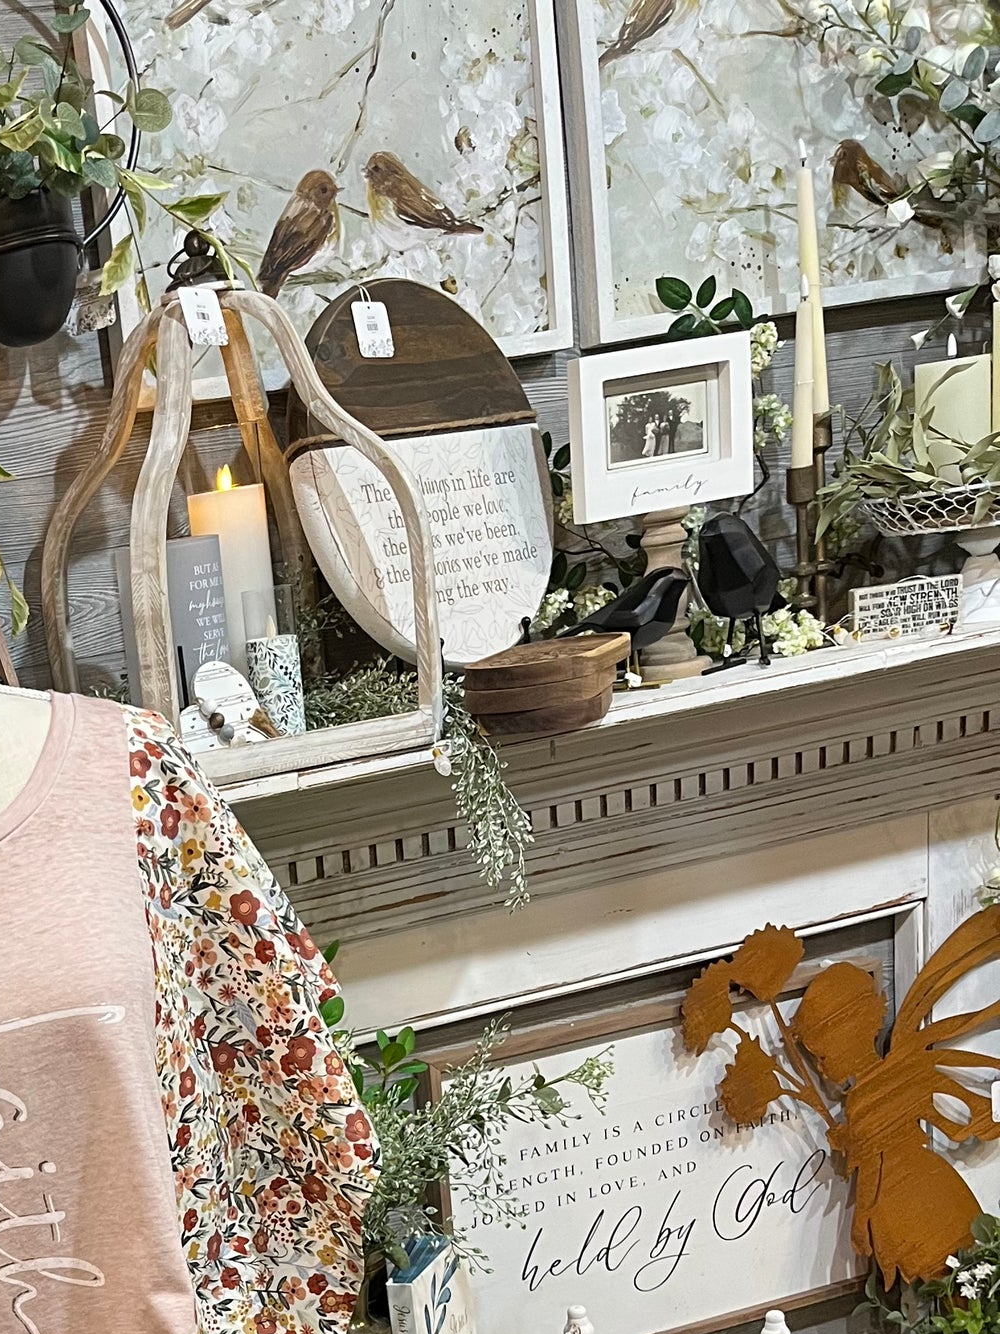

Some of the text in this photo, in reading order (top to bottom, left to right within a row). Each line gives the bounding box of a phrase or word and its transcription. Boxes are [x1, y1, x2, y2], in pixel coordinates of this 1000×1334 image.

[361, 470, 516, 504] The hings in life are
[631, 473, 708, 507] family
[388, 510, 406, 529] th
[426, 502, 460, 526] eople
[463, 502, 483, 517] we
[383, 538, 408, 557] the
[445, 527, 482, 548] we've
[194, 563, 211, 575] BUT
[386, 564, 411, 585] the
[462, 549, 498, 571] we've
[503, 541, 538, 564] made
[189, 579, 208, 591] FOR
[457, 579, 479, 599] the
[482, 576, 514, 594] way.
[896, 584, 917, 595] TRUST
[918, 583, 925, 591] IN
[940, 578, 959, 588] LORD
[196, 616, 211, 627] WE
[904, 604, 921, 615] HIGH
[923, 601, 934, 611] ON
[519, 1132, 592, 1161] FAMILY
[603, 1125, 621, 1141] IS
[633, 1120, 644, 1134] A
[655, 1100, 725, 1128] CIRCLE
[595, 1136, 688, 1170] FOUNDED
[699, 1126, 725, 1143] ON
[736, 1110, 799, 1134] FAITH,
[557, 1191, 577, 1207] IN
[588, 1176, 647, 1199] LOVE,
[658, 1161, 698, 1182] AND
[521, 1149, 828, 1293] held by God
